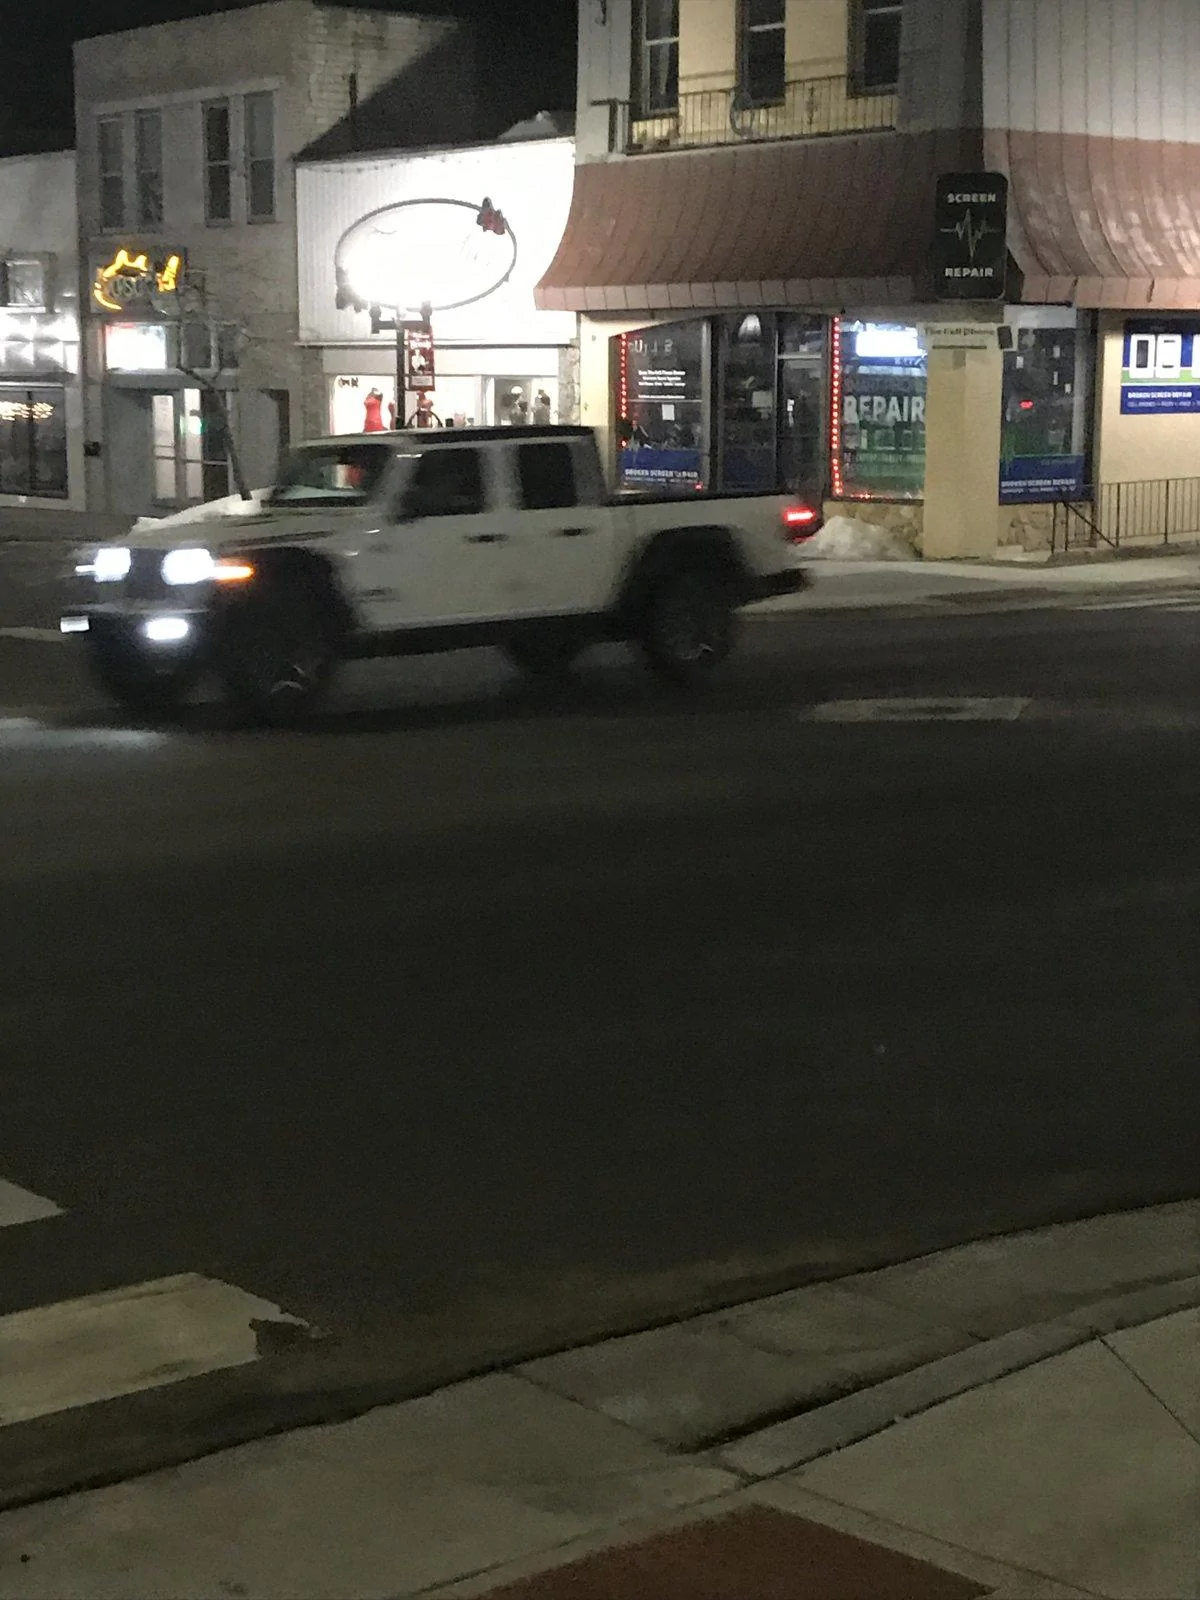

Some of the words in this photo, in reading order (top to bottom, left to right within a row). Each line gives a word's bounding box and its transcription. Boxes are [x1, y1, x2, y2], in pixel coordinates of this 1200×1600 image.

[947, 193, 996, 203] SCREEN
[945, 267, 994, 277] REPAIR
[843, 396, 925, 423] REPAIR
